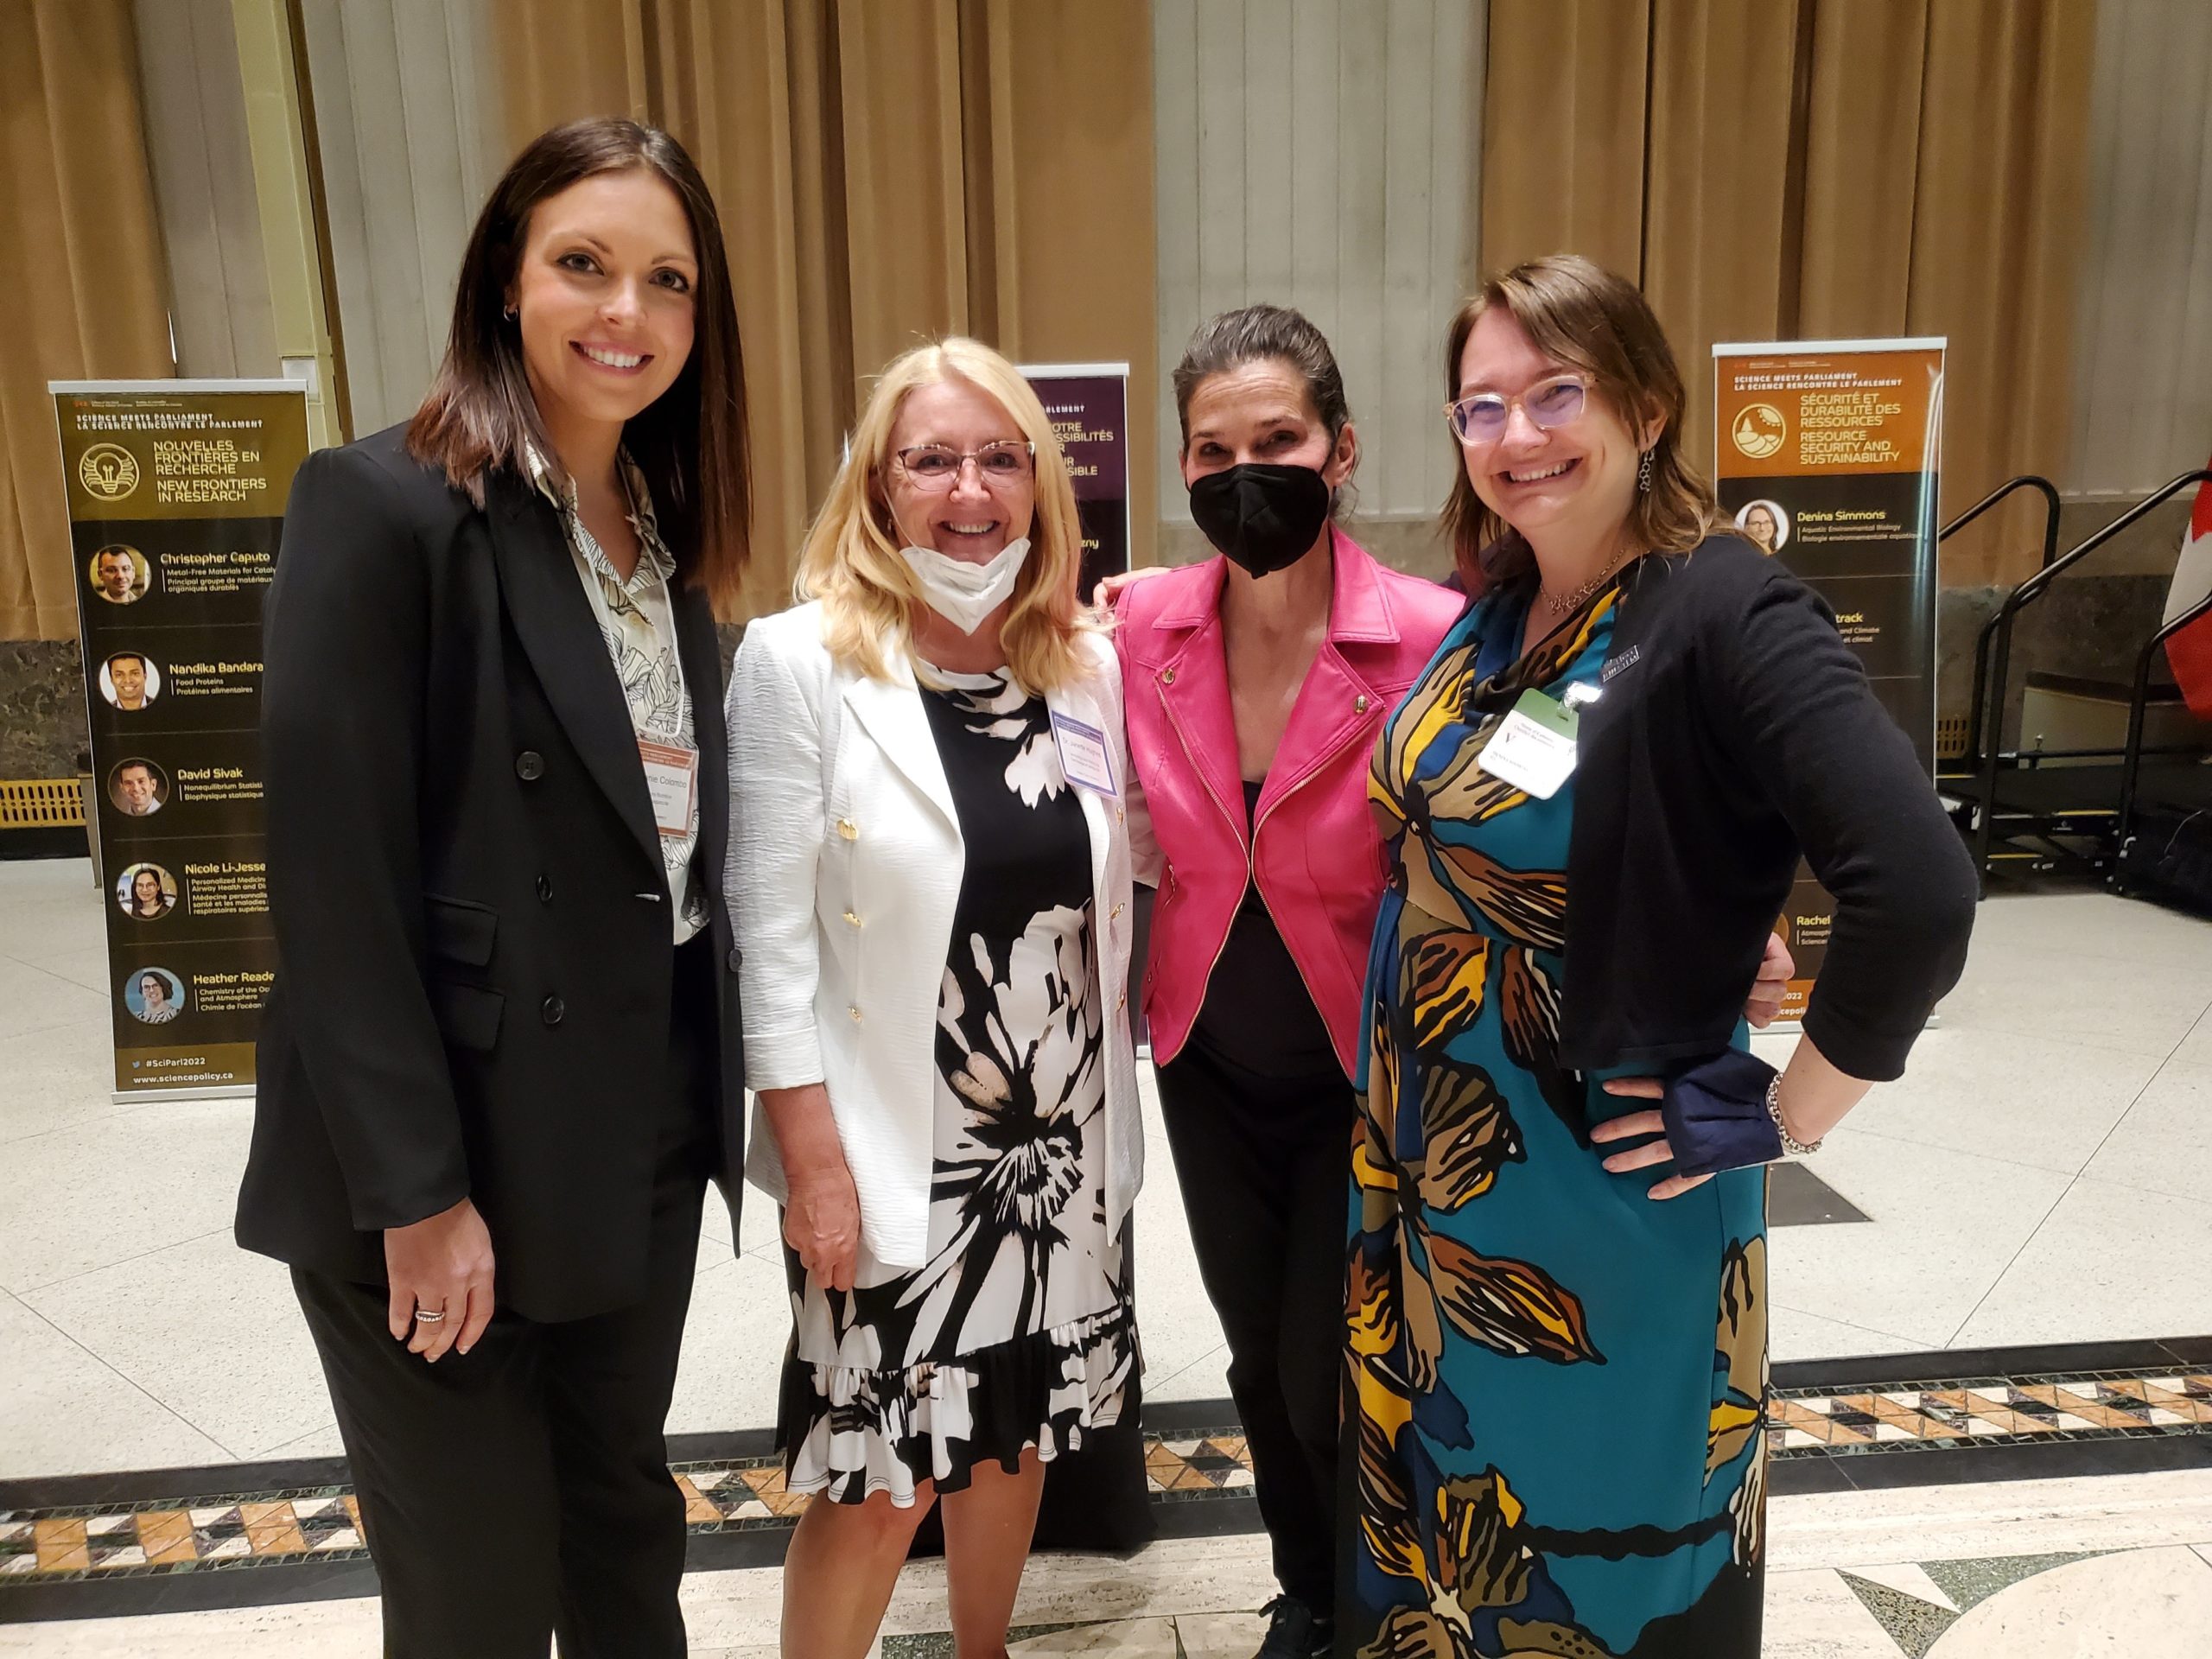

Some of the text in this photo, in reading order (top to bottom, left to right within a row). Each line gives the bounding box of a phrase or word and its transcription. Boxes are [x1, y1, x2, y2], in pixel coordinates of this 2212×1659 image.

[1801, 392, 1878, 405] SÉCURITÉ ET
[1801, 403, 1901, 416] DURABILITÉ DES
[154, 413, 213, 422] PARLIAMENT
[1801, 416, 1882, 427] RESSOURCES
[136, 421, 191, 429] RENCONTRE
[210, 419, 263, 429] PARLEMENT
[1056, 429, 1113, 442] SSIBILITÉS
[1801, 431, 1866, 442] RESOURCE
[154, 440, 233, 451] NOUVELLES
[1801, 441, 1891, 453] SECURITY AND
[155, 449, 259, 463] FRONTIÈRES EN
[1801, 451, 1900, 465] SUSTAINABILITY
[156, 464, 235, 475] RECHERCHE
[1067, 466, 1097, 476] SIBLE
[157, 478, 266, 491] NEW FRONTIERS
[158, 491, 245, 503] IN RESEARCH
[1797, 511, 1885, 522] Denina Simmons
[160, 551, 270, 565] Christopher Caputo
[169, 662, 264, 675] Nandika Bandara
[211, 686, 252, 695] alimentaires
[178, 767, 243, 780] David Sivak
[184, 783, 237, 791] Nonequilibrium
[185, 792, 226, 801] Biophysique
[185, 863, 219, 874] Nicole
[1796, 915, 1830, 925] Rachel
[194, 973, 238, 984] Heather
[146, 1057, 206, 1068] #SciParl2022
[133, 1071, 233, 1084] www.sciencepolicy.ca
